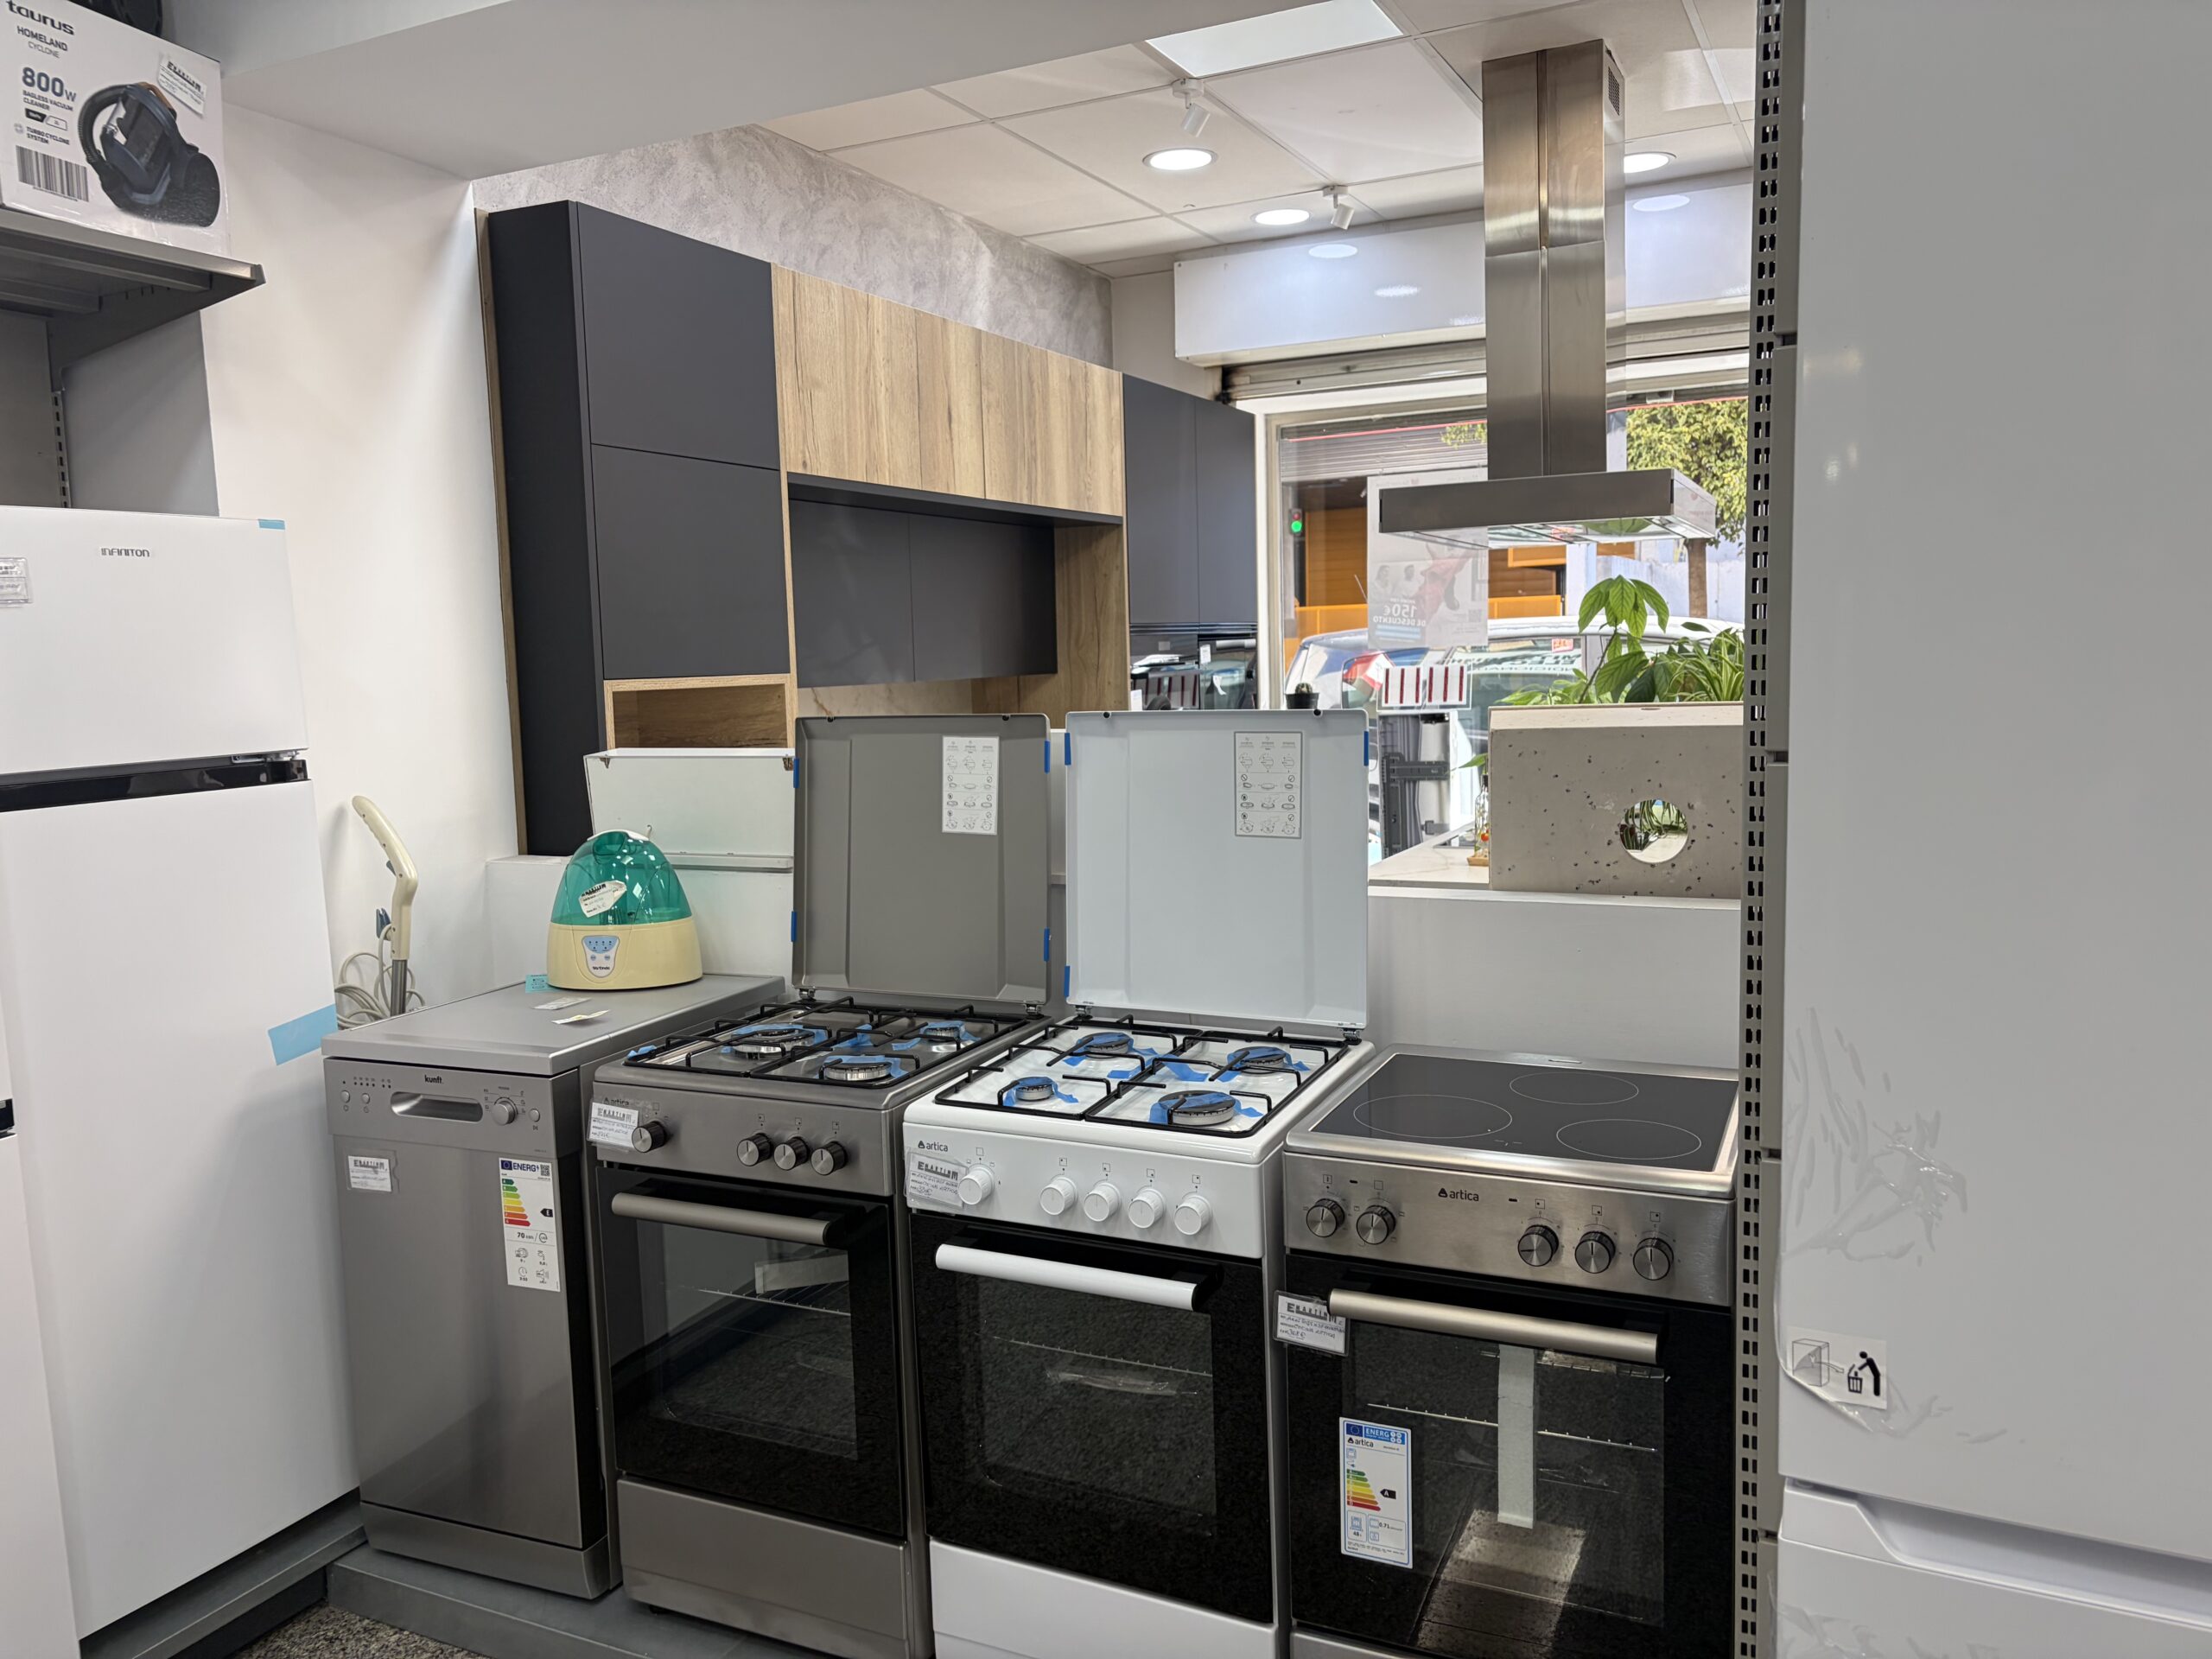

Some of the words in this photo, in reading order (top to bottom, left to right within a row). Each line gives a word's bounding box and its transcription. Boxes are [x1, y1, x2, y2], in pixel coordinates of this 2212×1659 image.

[6, 0, 74, 35] taurus
[17, 26, 68, 52] HOMELAND
[28, 41, 60, 59] CYCLONE
[22, 98, 49, 110] CLEANER
[424, 1075, 442, 1084] kunft
[926, 1142, 948, 1152] artica
[513, 1163, 536, 1172] ENERG
[1449, 1190, 1479, 1201] artica
[1366, 1428, 1389, 1438] ENERG
[1355, 1439, 1374, 1447] artica
